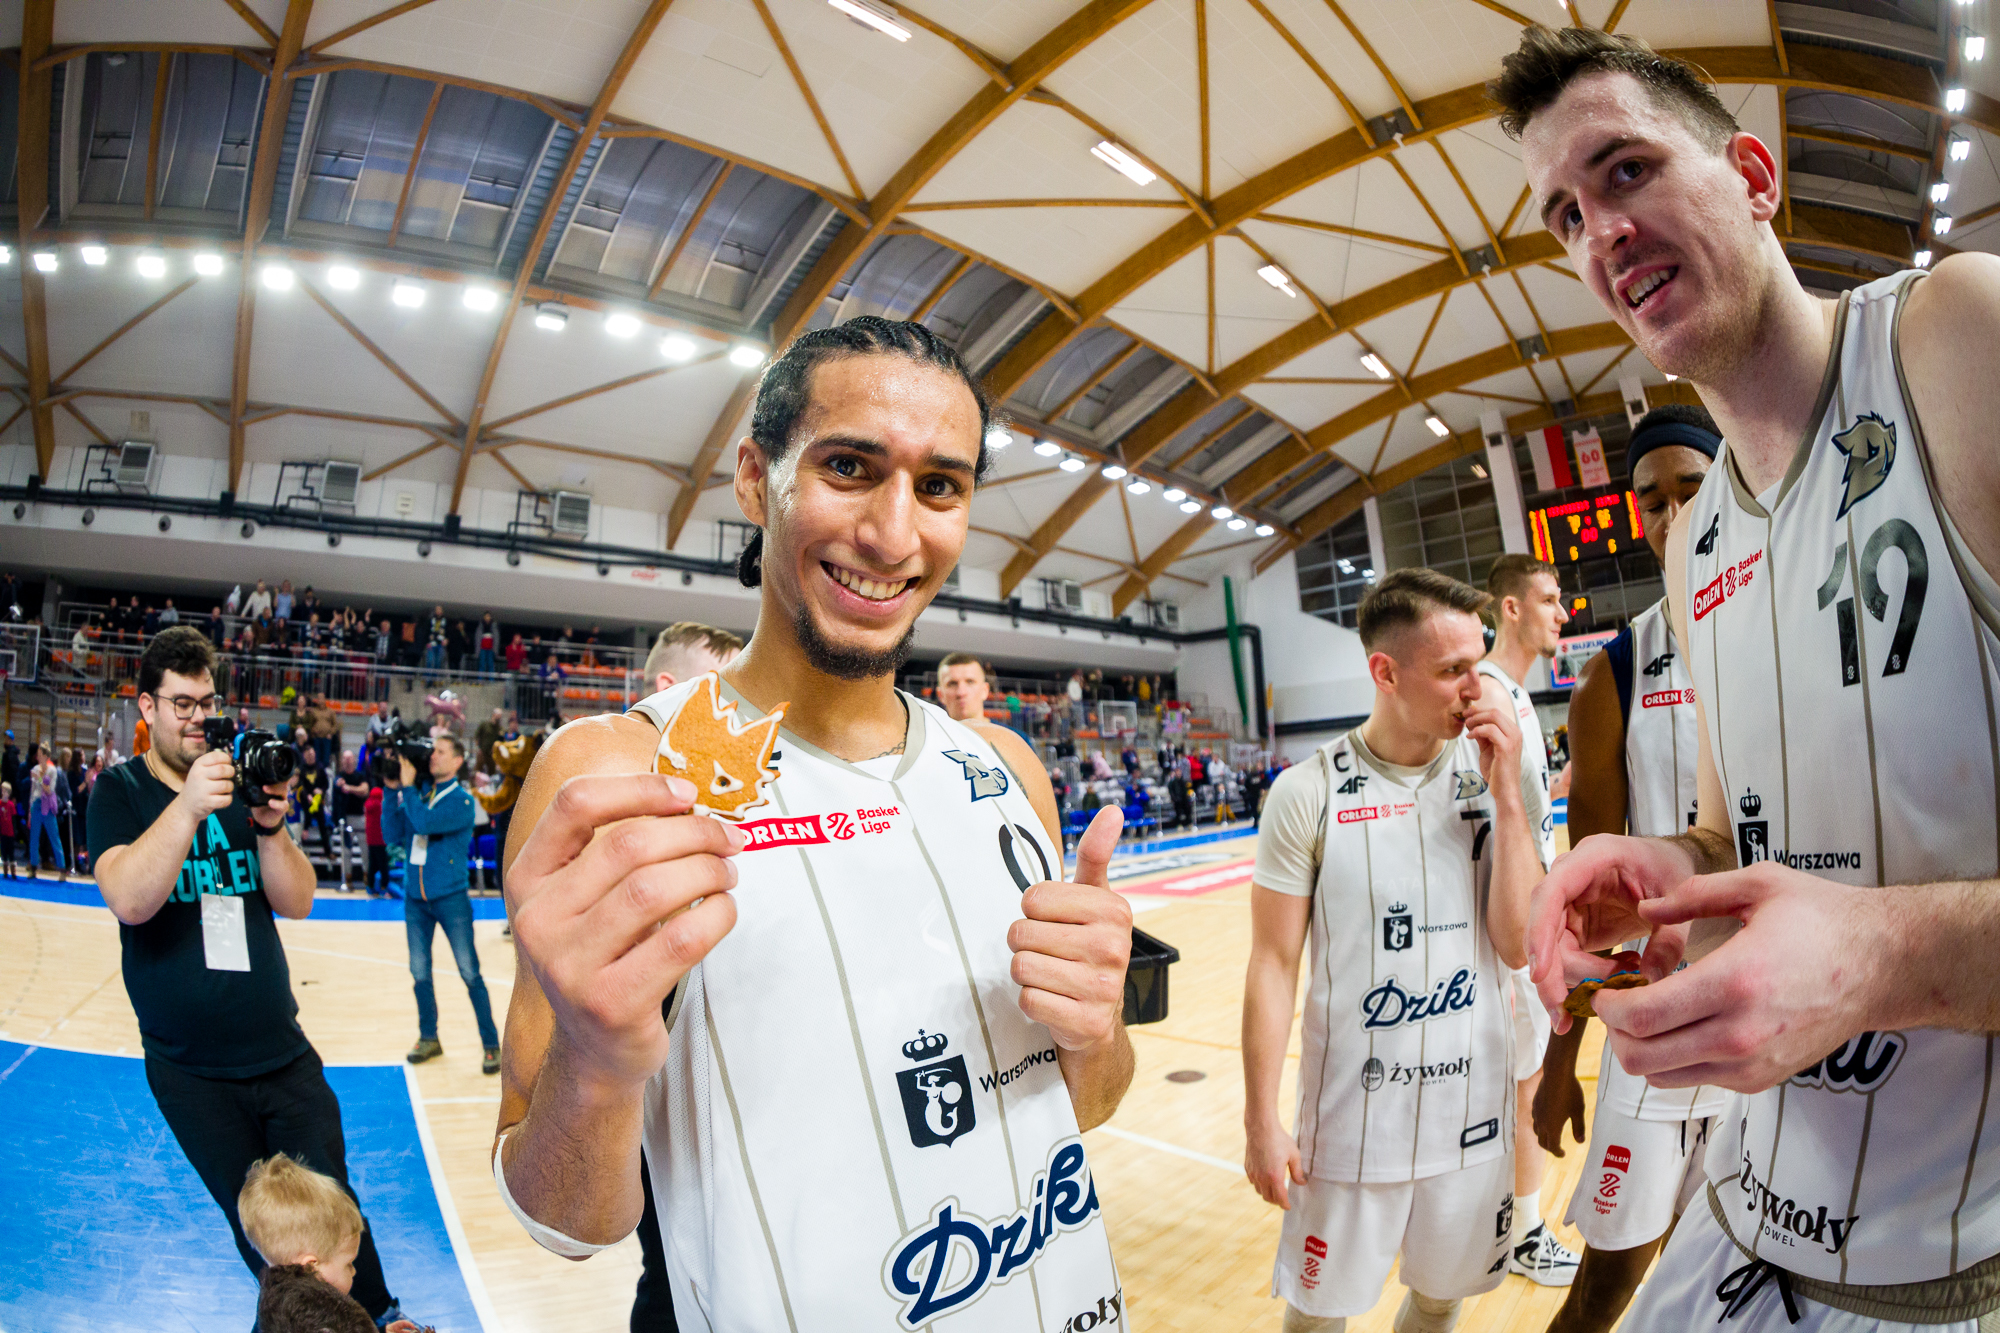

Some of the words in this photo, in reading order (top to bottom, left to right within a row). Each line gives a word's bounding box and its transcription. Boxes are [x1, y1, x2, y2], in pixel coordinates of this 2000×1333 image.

[1581, 449, 1600, 464] 60
[1695, 582, 1720, 615] ORLEN
[1738, 549, 1763, 573] Basket
[1738, 570, 1753, 587] Liga
[1817, 518, 1929, 687] 19
[1643, 653, 1675, 678] 4F
[1644, 692, 1679, 707] ORLEN
[1334, 752, 1351, 772] C
[1337, 775, 1368, 794] 4F
[856, 806, 901, 821] Basket
[1340, 808, 1376, 823] ORLEN
[861, 820, 891, 834] Liga
[1774, 850, 1861, 869] Warszawa
[1417, 921, 1468, 934] Warszawa
[978, 1048, 1057, 1093] Warszawa
[1389, 1057, 1473, 1086] Żywioły
[1606, 1153, 1629, 1164] ORLEN
[1593, 1196, 1617, 1208] Basket
[1595, 1205, 1611, 1215] Liga
[1740, 1150, 1860, 1254] Żywioły
